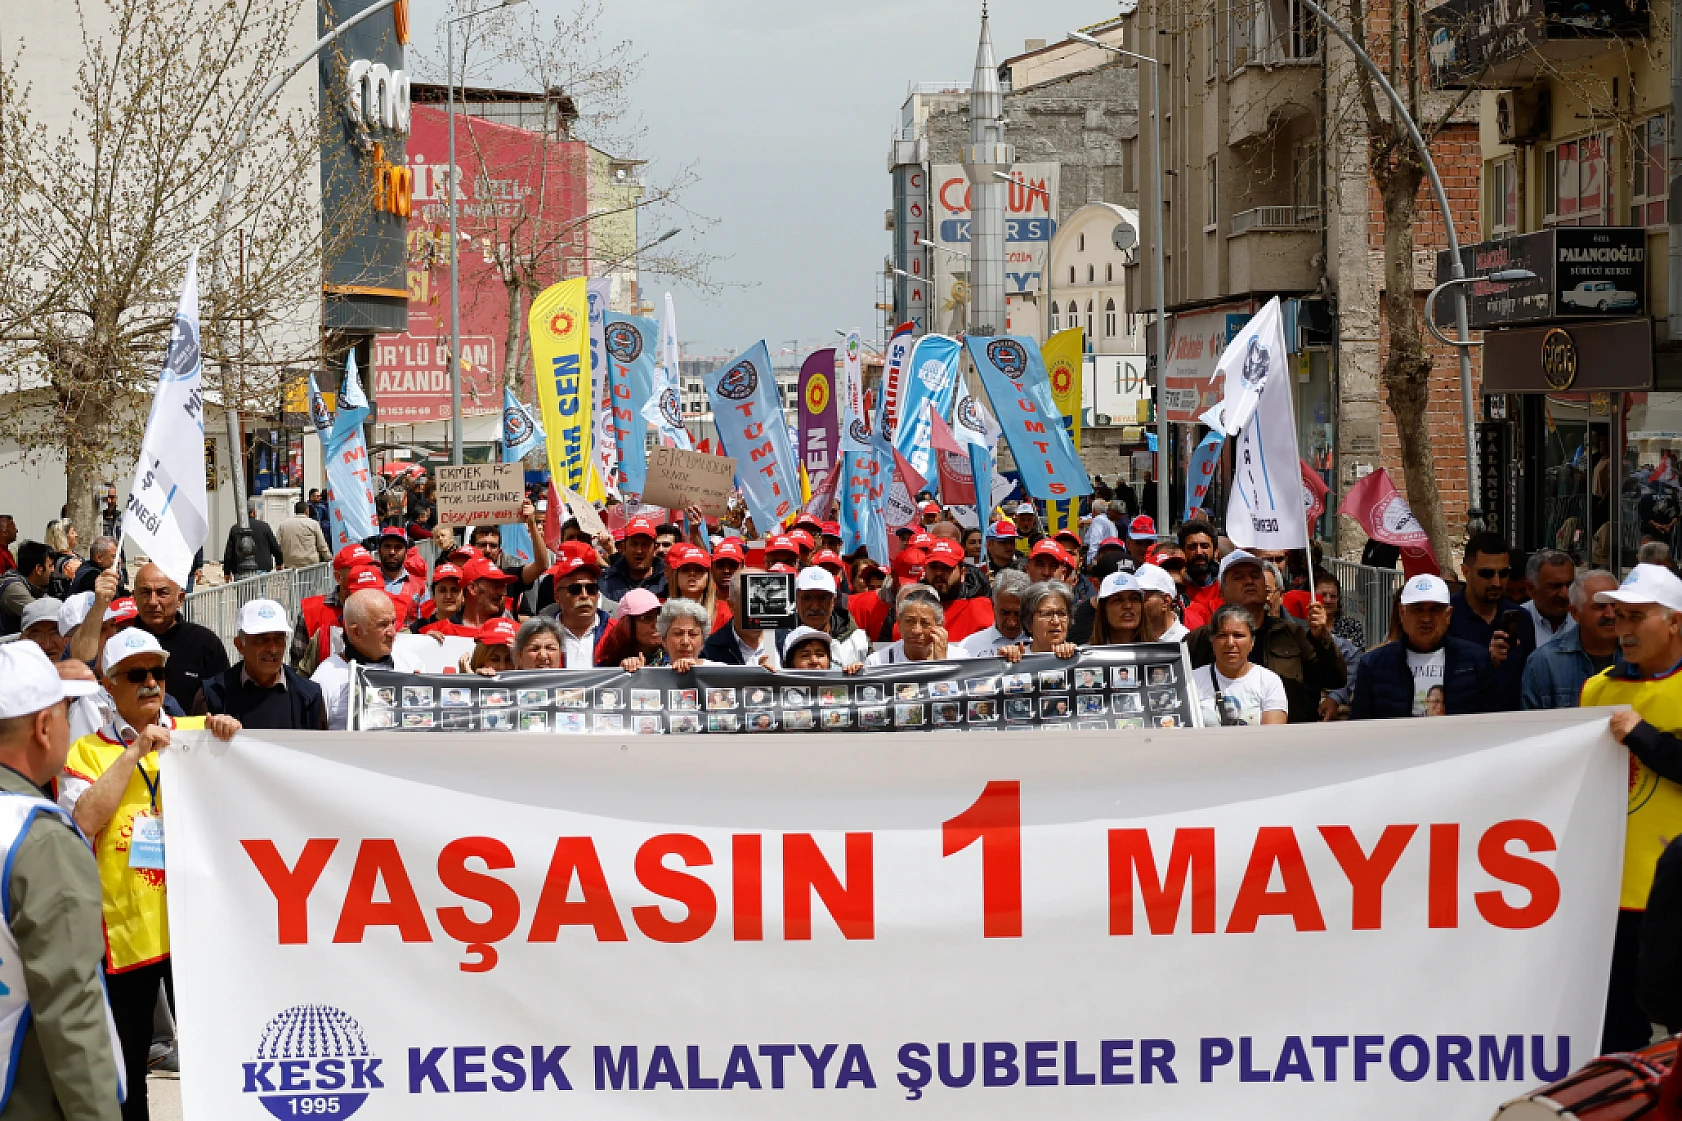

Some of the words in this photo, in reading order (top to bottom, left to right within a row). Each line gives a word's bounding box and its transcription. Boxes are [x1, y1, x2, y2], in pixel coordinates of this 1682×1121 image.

[940, 172, 1049, 215] ÇÜM
[910, 174, 923, 301] ÇÖZÜM
[957, 222, 1042, 240] KRS
[1559, 245, 1644, 262] PALANCIOĞLU
[436, 345, 487, 366] OAN
[735, 402, 790, 517] TÜMTİS
[241, 833, 874, 972] YAŞASIN
[943, 781, 1022, 938] 1
[1108, 820, 1560, 935] MAYIS
[242, 1059, 384, 1092] KESK
[409, 1046, 572, 1093] KESK
[595, 1044, 876, 1091] MALATYA
[897, 1040, 1177, 1100] ŞUBELER
[1201, 1035, 1570, 1083] PLATFORMU
[288, 1097, 341, 1116] 1995
